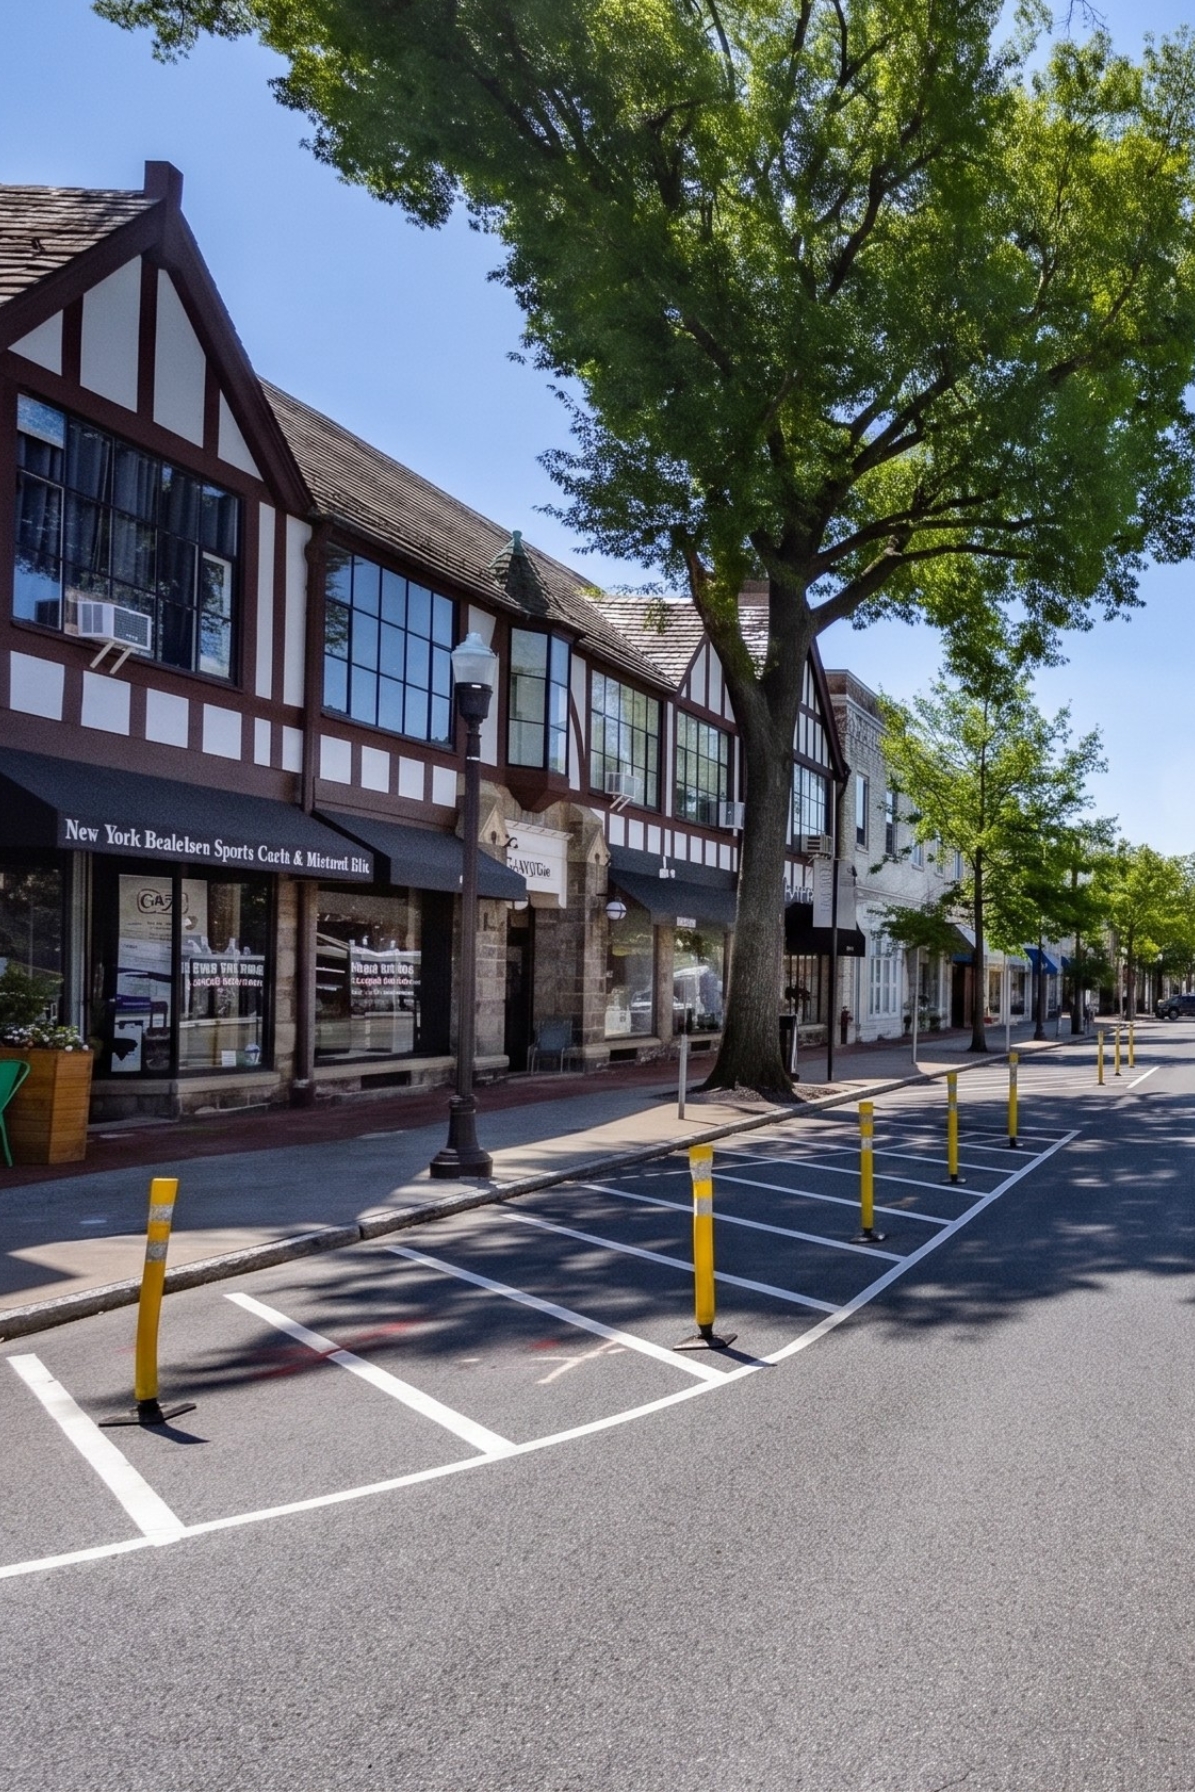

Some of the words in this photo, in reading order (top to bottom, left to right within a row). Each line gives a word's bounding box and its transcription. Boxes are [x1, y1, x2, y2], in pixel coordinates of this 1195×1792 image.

[65, 819, 99, 842] New
[104, 824, 141, 847] York
[214, 839, 254, 862] Sports
[293, 850, 303, 866] &
